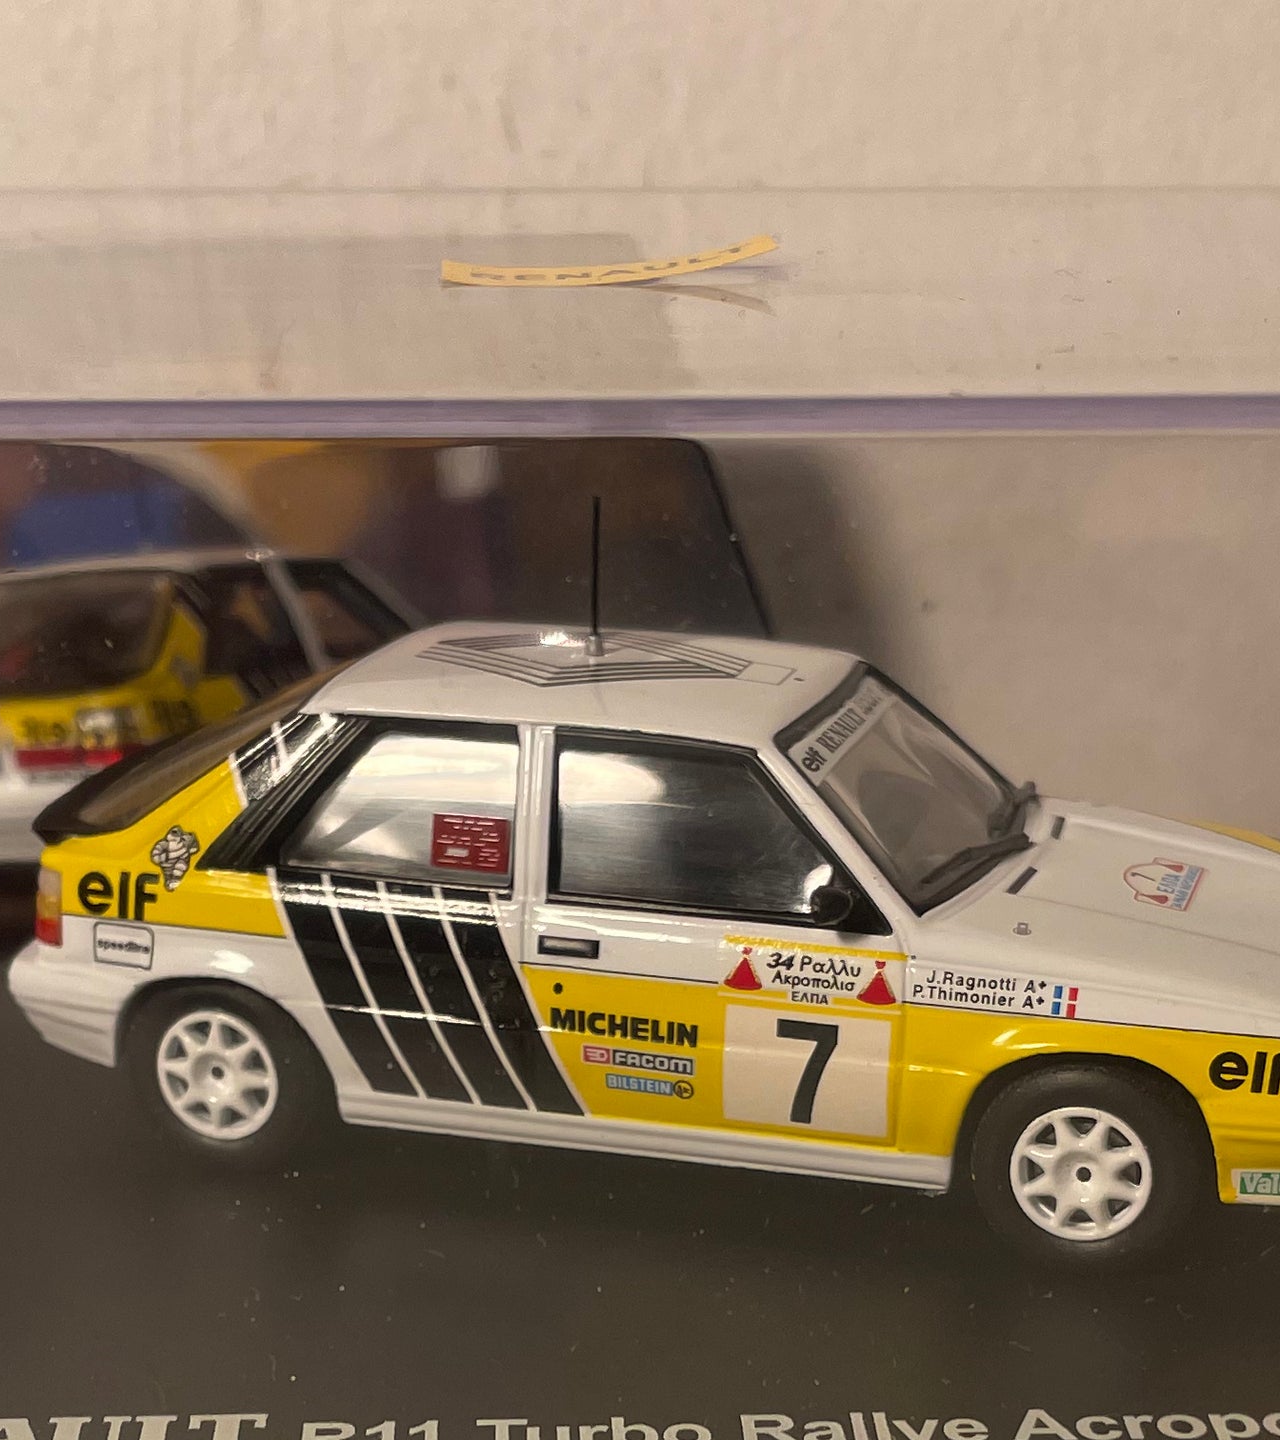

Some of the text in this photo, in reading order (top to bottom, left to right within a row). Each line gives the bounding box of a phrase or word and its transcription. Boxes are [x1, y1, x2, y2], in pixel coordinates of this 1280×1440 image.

[802, 707, 866, 773] elf RENAULT
[77, 871, 159, 921] elf
[766, 952, 795, 970] 34
[926, 970, 1016, 992] J.Ragnotti
[913, 984, 1015, 1008] P.Thimonier
[551, 1007, 698, 1047] MICHELIN
[614, 1051, 692, 1073] FACOM
[776, 1018, 839, 1124] 7
[607, 1075, 671, 1094] BILSTEIN
